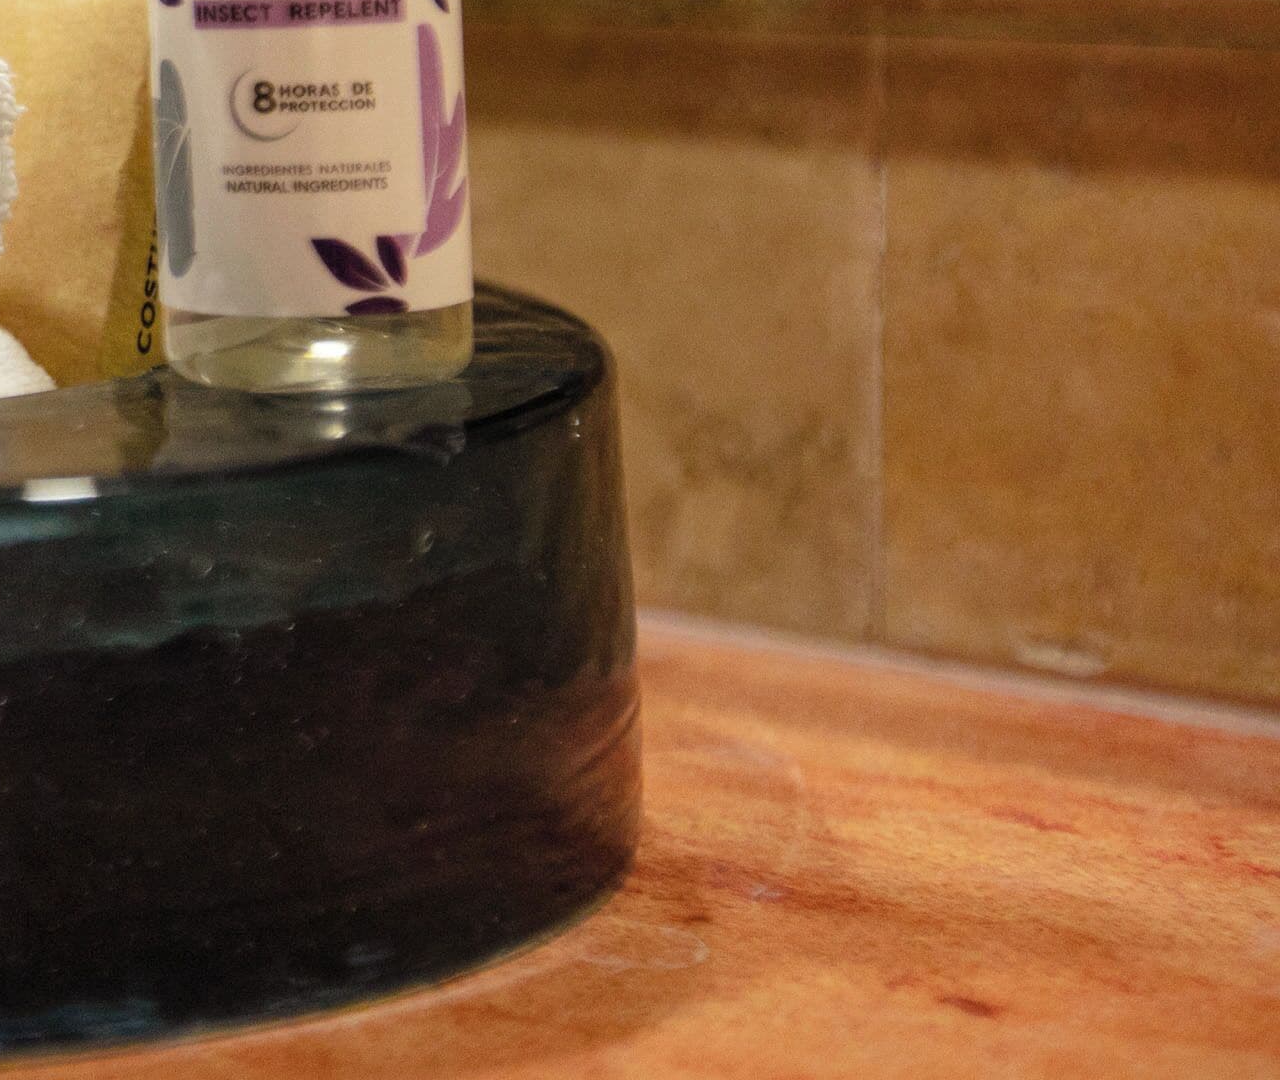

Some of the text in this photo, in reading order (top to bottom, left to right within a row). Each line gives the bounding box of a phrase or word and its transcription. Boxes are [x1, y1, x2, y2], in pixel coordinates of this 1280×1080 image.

[196, 4, 272, 23] INSECT
[253, 80, 277, 114] 8
[279, 81, 375, 99] HORAS DE
[279, 97, 377, 113] PROTECCION
[223, 160, 393, 177] INGREDIENTES NATURALES
[227, 176, 389, 194] NATURAL INGREDIENTS
